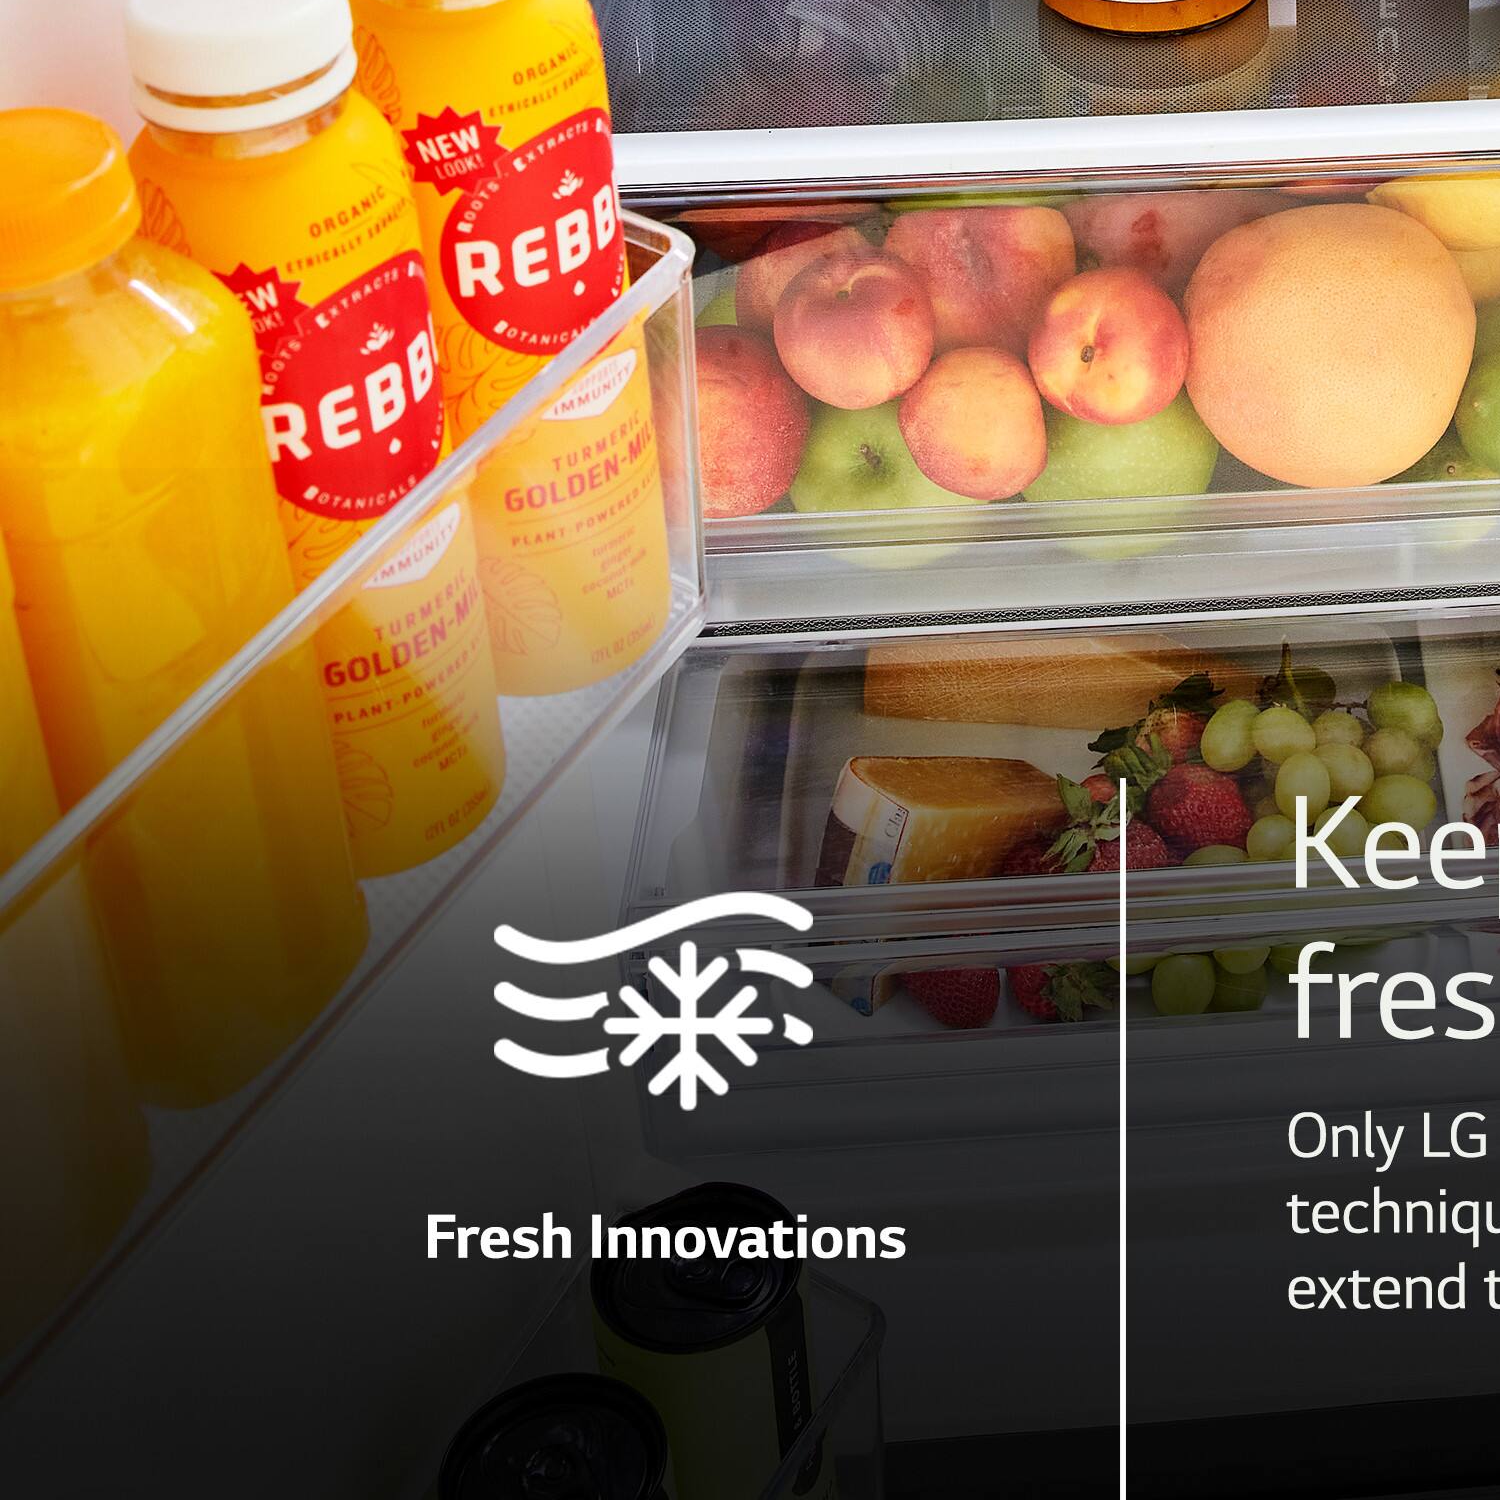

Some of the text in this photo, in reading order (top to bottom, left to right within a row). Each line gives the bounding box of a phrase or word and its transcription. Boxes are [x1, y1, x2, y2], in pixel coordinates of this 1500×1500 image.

[513, 43, 578, 86] ORGANIC
[416, 125, 480, 164] NEW
[435, 154, 484, 180] LOOK!
[308, 184, 386, 240] ORGANIC
[552, 361, 632, 417] IMMUNITY
[552, 410, 641, 473] TURMERIC
[373, 566, 467, 643] TURMERIC
